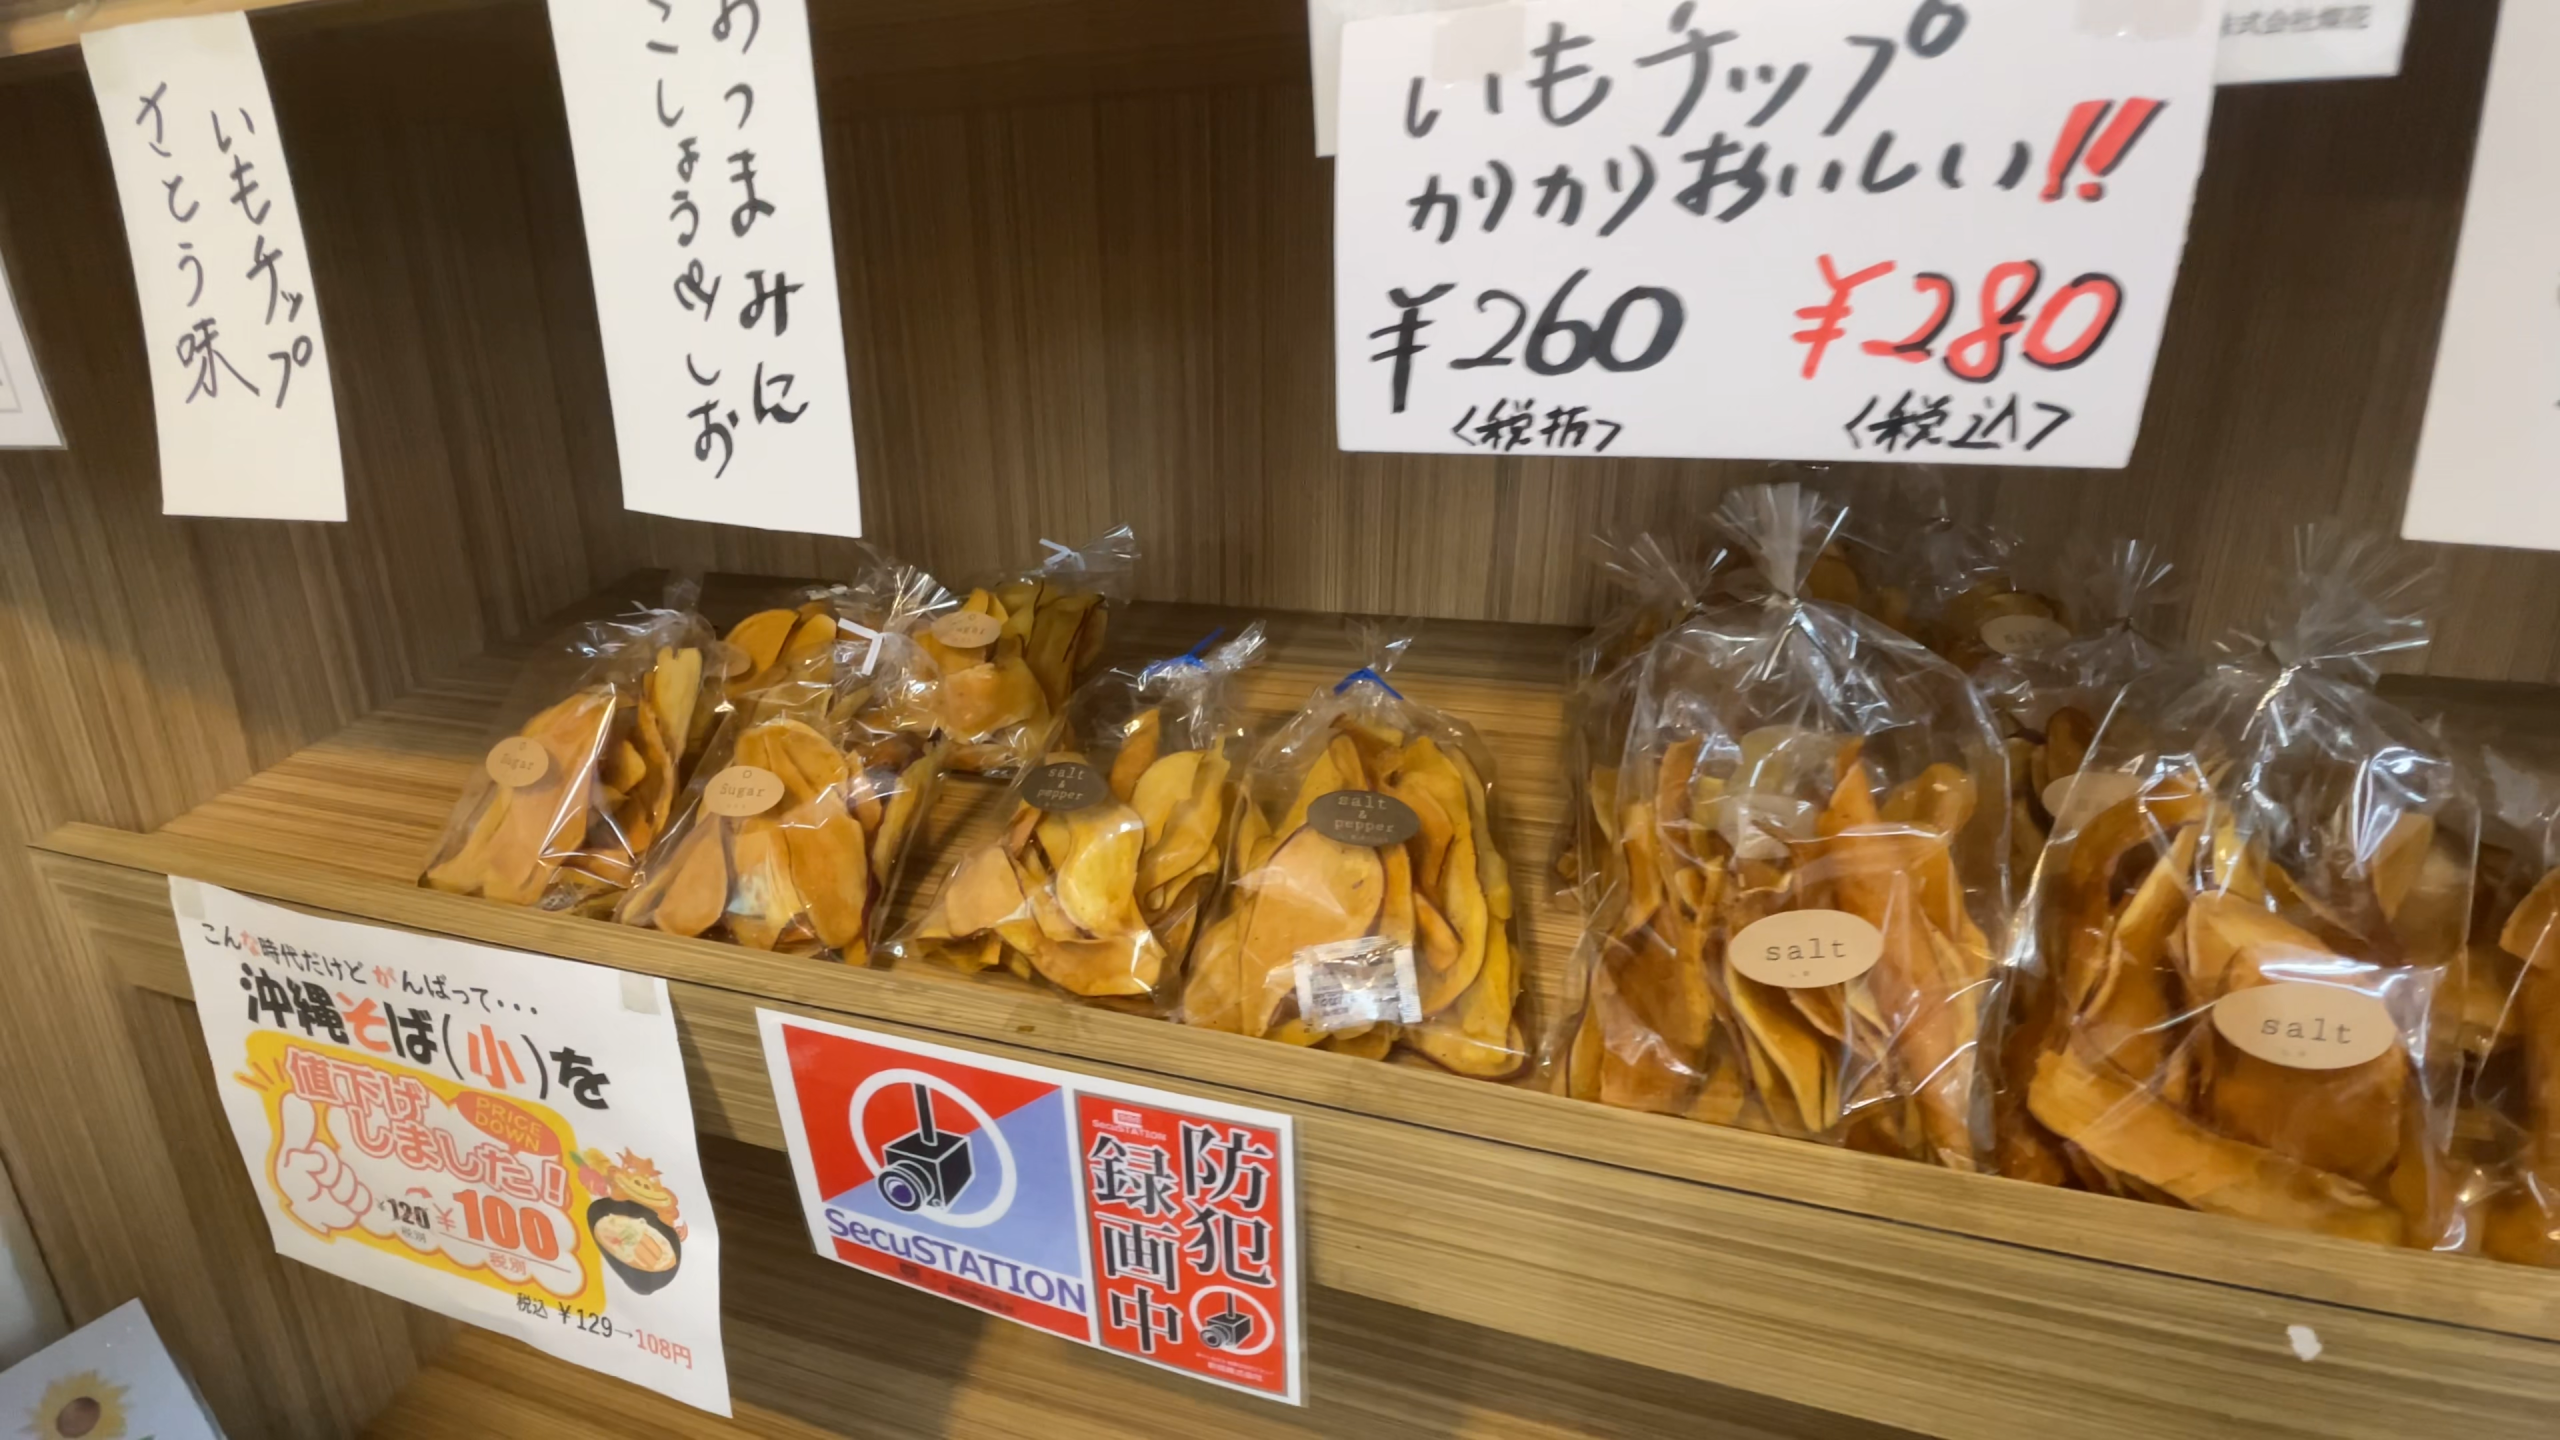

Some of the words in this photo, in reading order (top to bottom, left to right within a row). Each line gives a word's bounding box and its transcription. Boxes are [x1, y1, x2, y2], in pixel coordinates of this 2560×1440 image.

[1404, 0, 1967, 138] いもチップ
[136, 82, 260, 404] さとう味
[212, 107, 313, 408] いもチップ
[1370, 267, 1686, 414] ¥260
[1793, 253, 2124, 384] ¥280
[720, 782, 766, 799] Sugar
[1334, 819, 1395, 833] pepper
[1338, 795, 1387, 810] salt
[1765, 937, 1847, 962] salt
[2260, 1017, 2352, 1045] salt
[285, 1046, 430, 1122] 値下げ
[476, 1096, 542, 1138] PRICE
[475, 1110, 540, 1152] DOWN
[1179, 1120, 1276, 1289] 防犯
[824, 1206, 1088, 1314] SecuSTATION
[1088, 1133, 1184, 1354] 録画中
[516, 1291, 549, 1319] 税込
